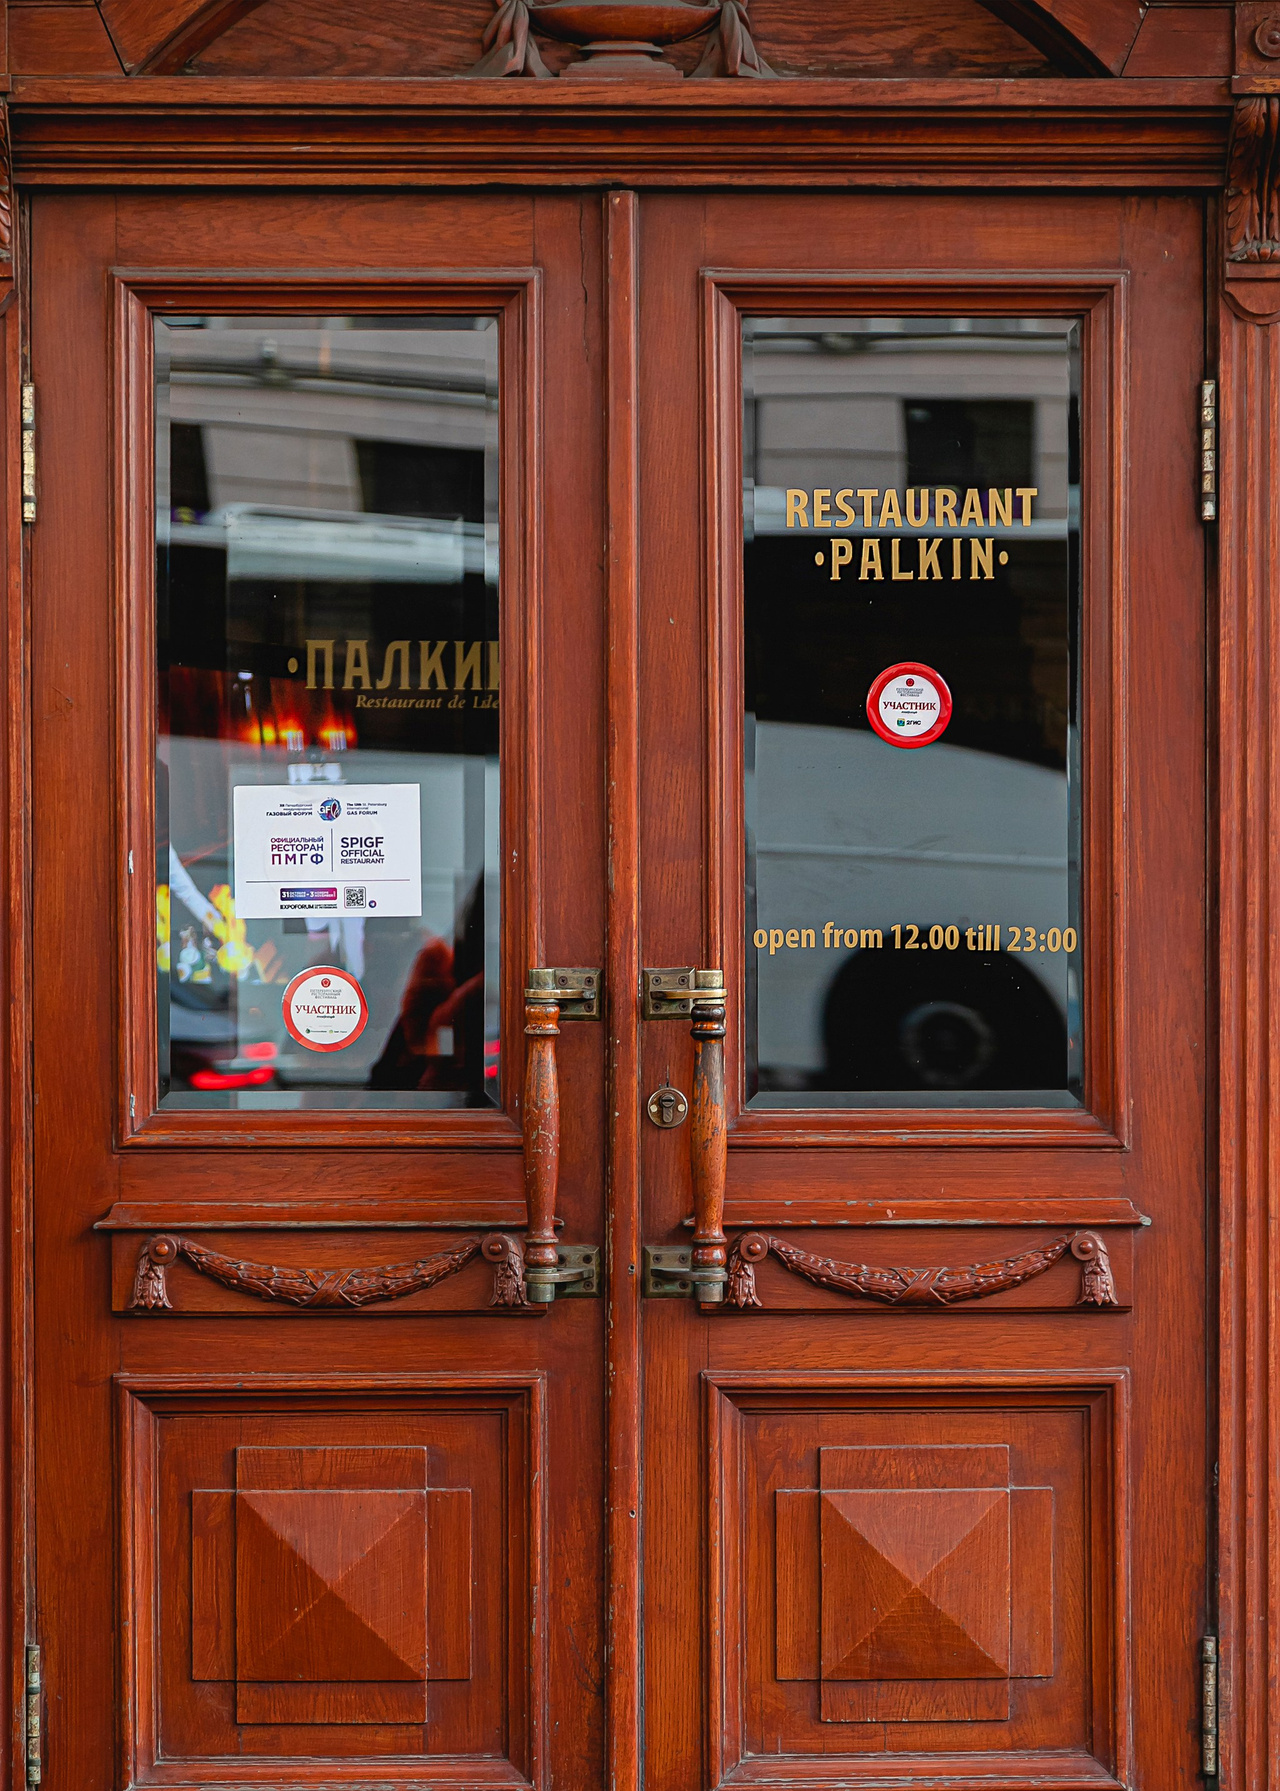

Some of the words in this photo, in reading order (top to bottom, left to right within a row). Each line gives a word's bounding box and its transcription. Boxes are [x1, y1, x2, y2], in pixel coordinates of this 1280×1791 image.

[785, 487, 1038, 528] RESTAURANT
[356, 694, 442, 709] Restaurant
[447, 694, 466, 709] de
[883, 701, 937, 711] УЧАСТНИК
[270, 836, 324, 844] ОФИЦИАЛЬНЫЙ
[340, 836, 384, 848] SPIGF
[271, 843, 324, 852] РЕСТОРАН
[340, 849, 384, 858] OFFICIAL
[340, 857, 384, 865] RESTAURANT
[752, 927, 816, 955] open
[822, 921, 883, 949] from
[890, 924, 960, 950] 12.00
[965, 924, 1000, 952] till
[1006, 926, 1078, 953] 23:00
[295, 1004, 357, 1015] УЧАСТНИК
